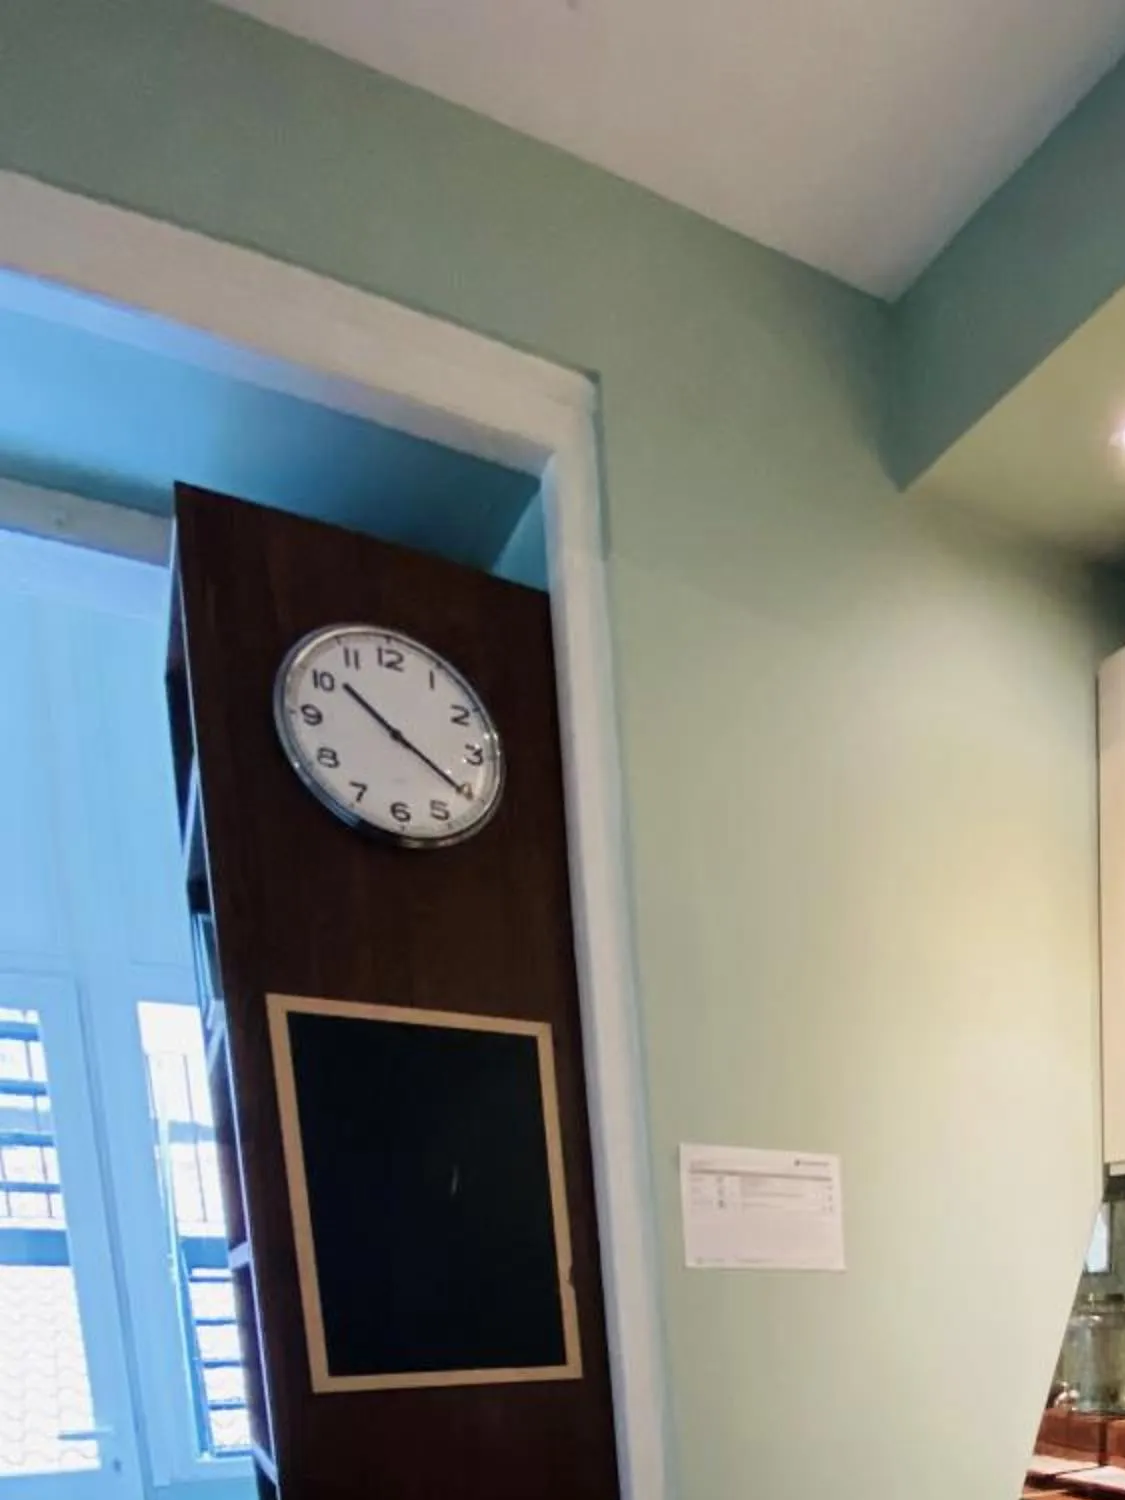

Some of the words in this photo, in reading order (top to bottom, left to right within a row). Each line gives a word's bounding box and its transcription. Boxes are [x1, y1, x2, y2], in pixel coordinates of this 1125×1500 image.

[344, 647, 360, 670] 11
[377, 646, 404, 672] 12
[312, 668, 335, 691] 10
[428, 670, 436, 690] 1
[301, 704, 323, 726] 9
[450, 704, 471, 727] 2
[316, 747, 339, 769] 8
[465, 744, 485, 767] 3
[349, 781, 368, 802] 7
[390, 802, 412, 822] 6
[429, 800, 450, 821] 5
